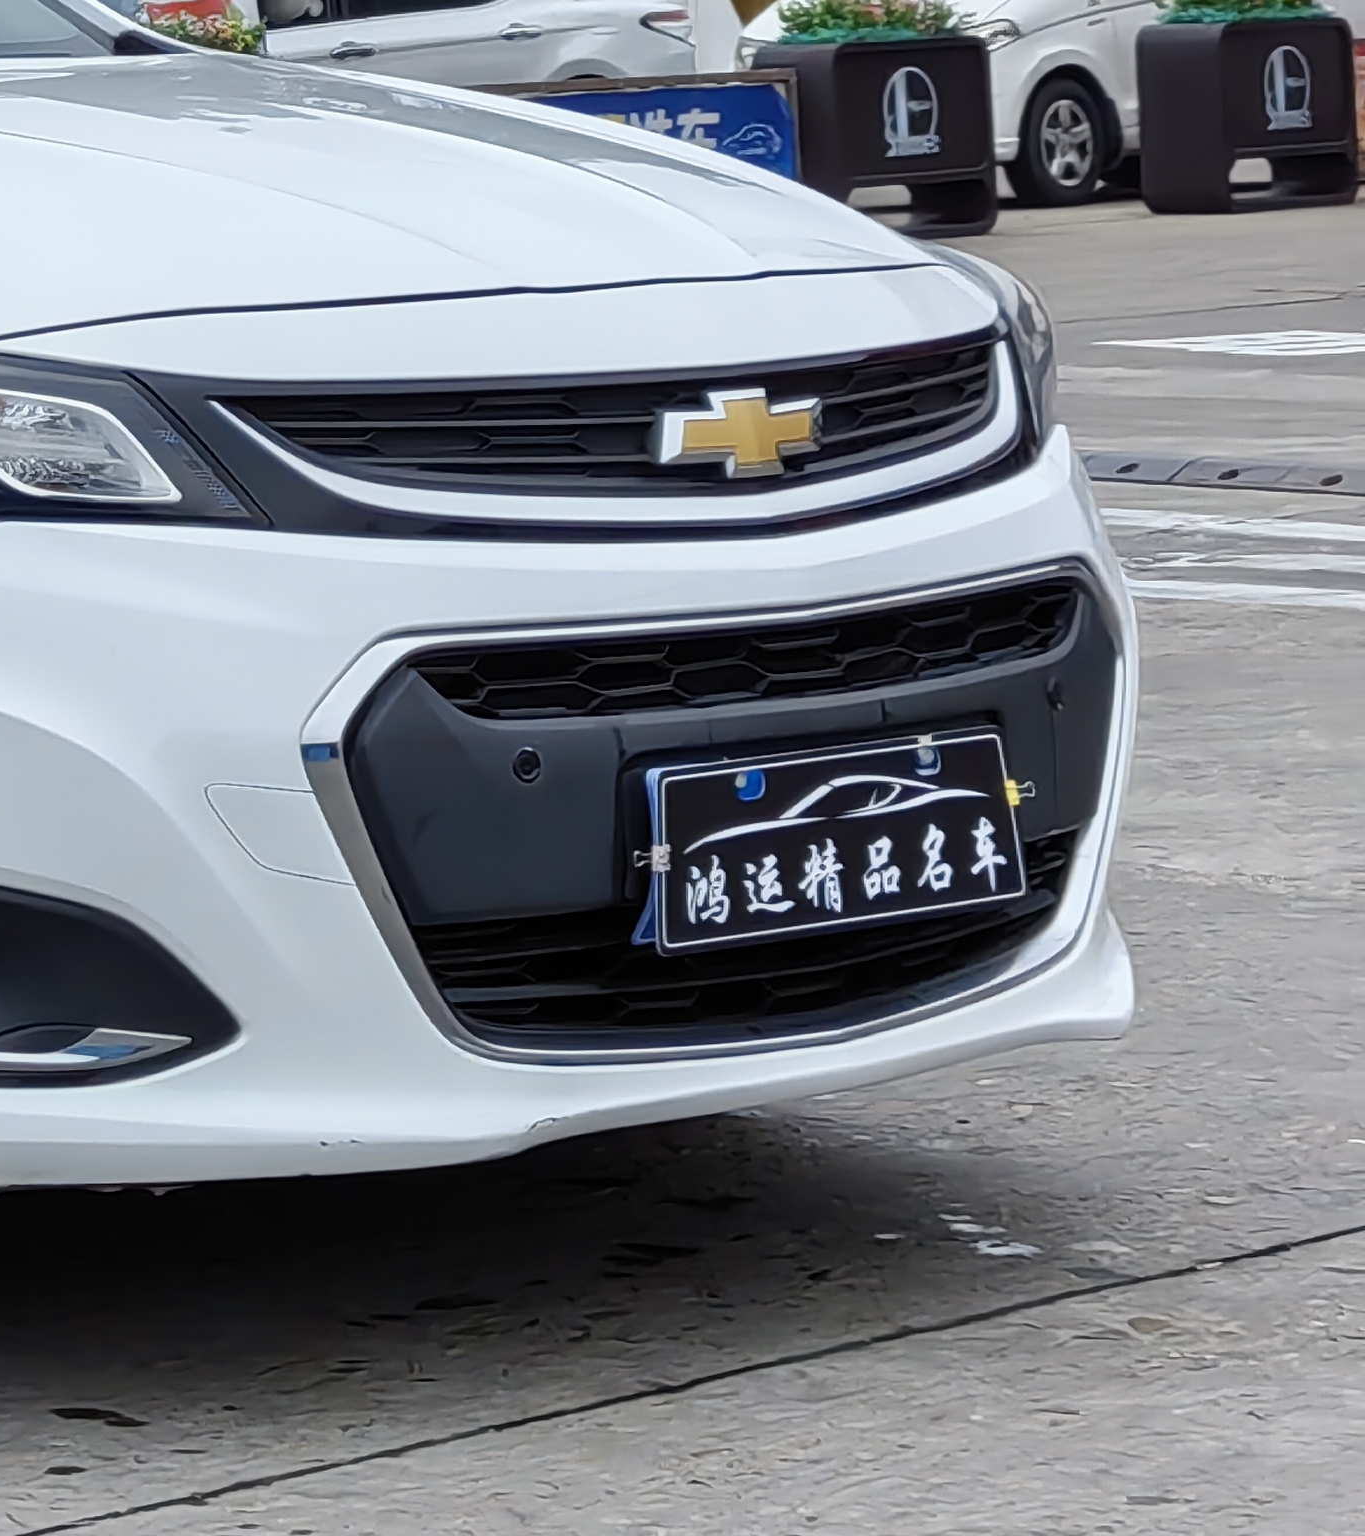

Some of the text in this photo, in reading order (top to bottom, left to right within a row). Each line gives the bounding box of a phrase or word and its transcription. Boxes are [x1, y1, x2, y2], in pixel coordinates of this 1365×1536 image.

[686, 816, 1007, 924] 鸿运精品名车
